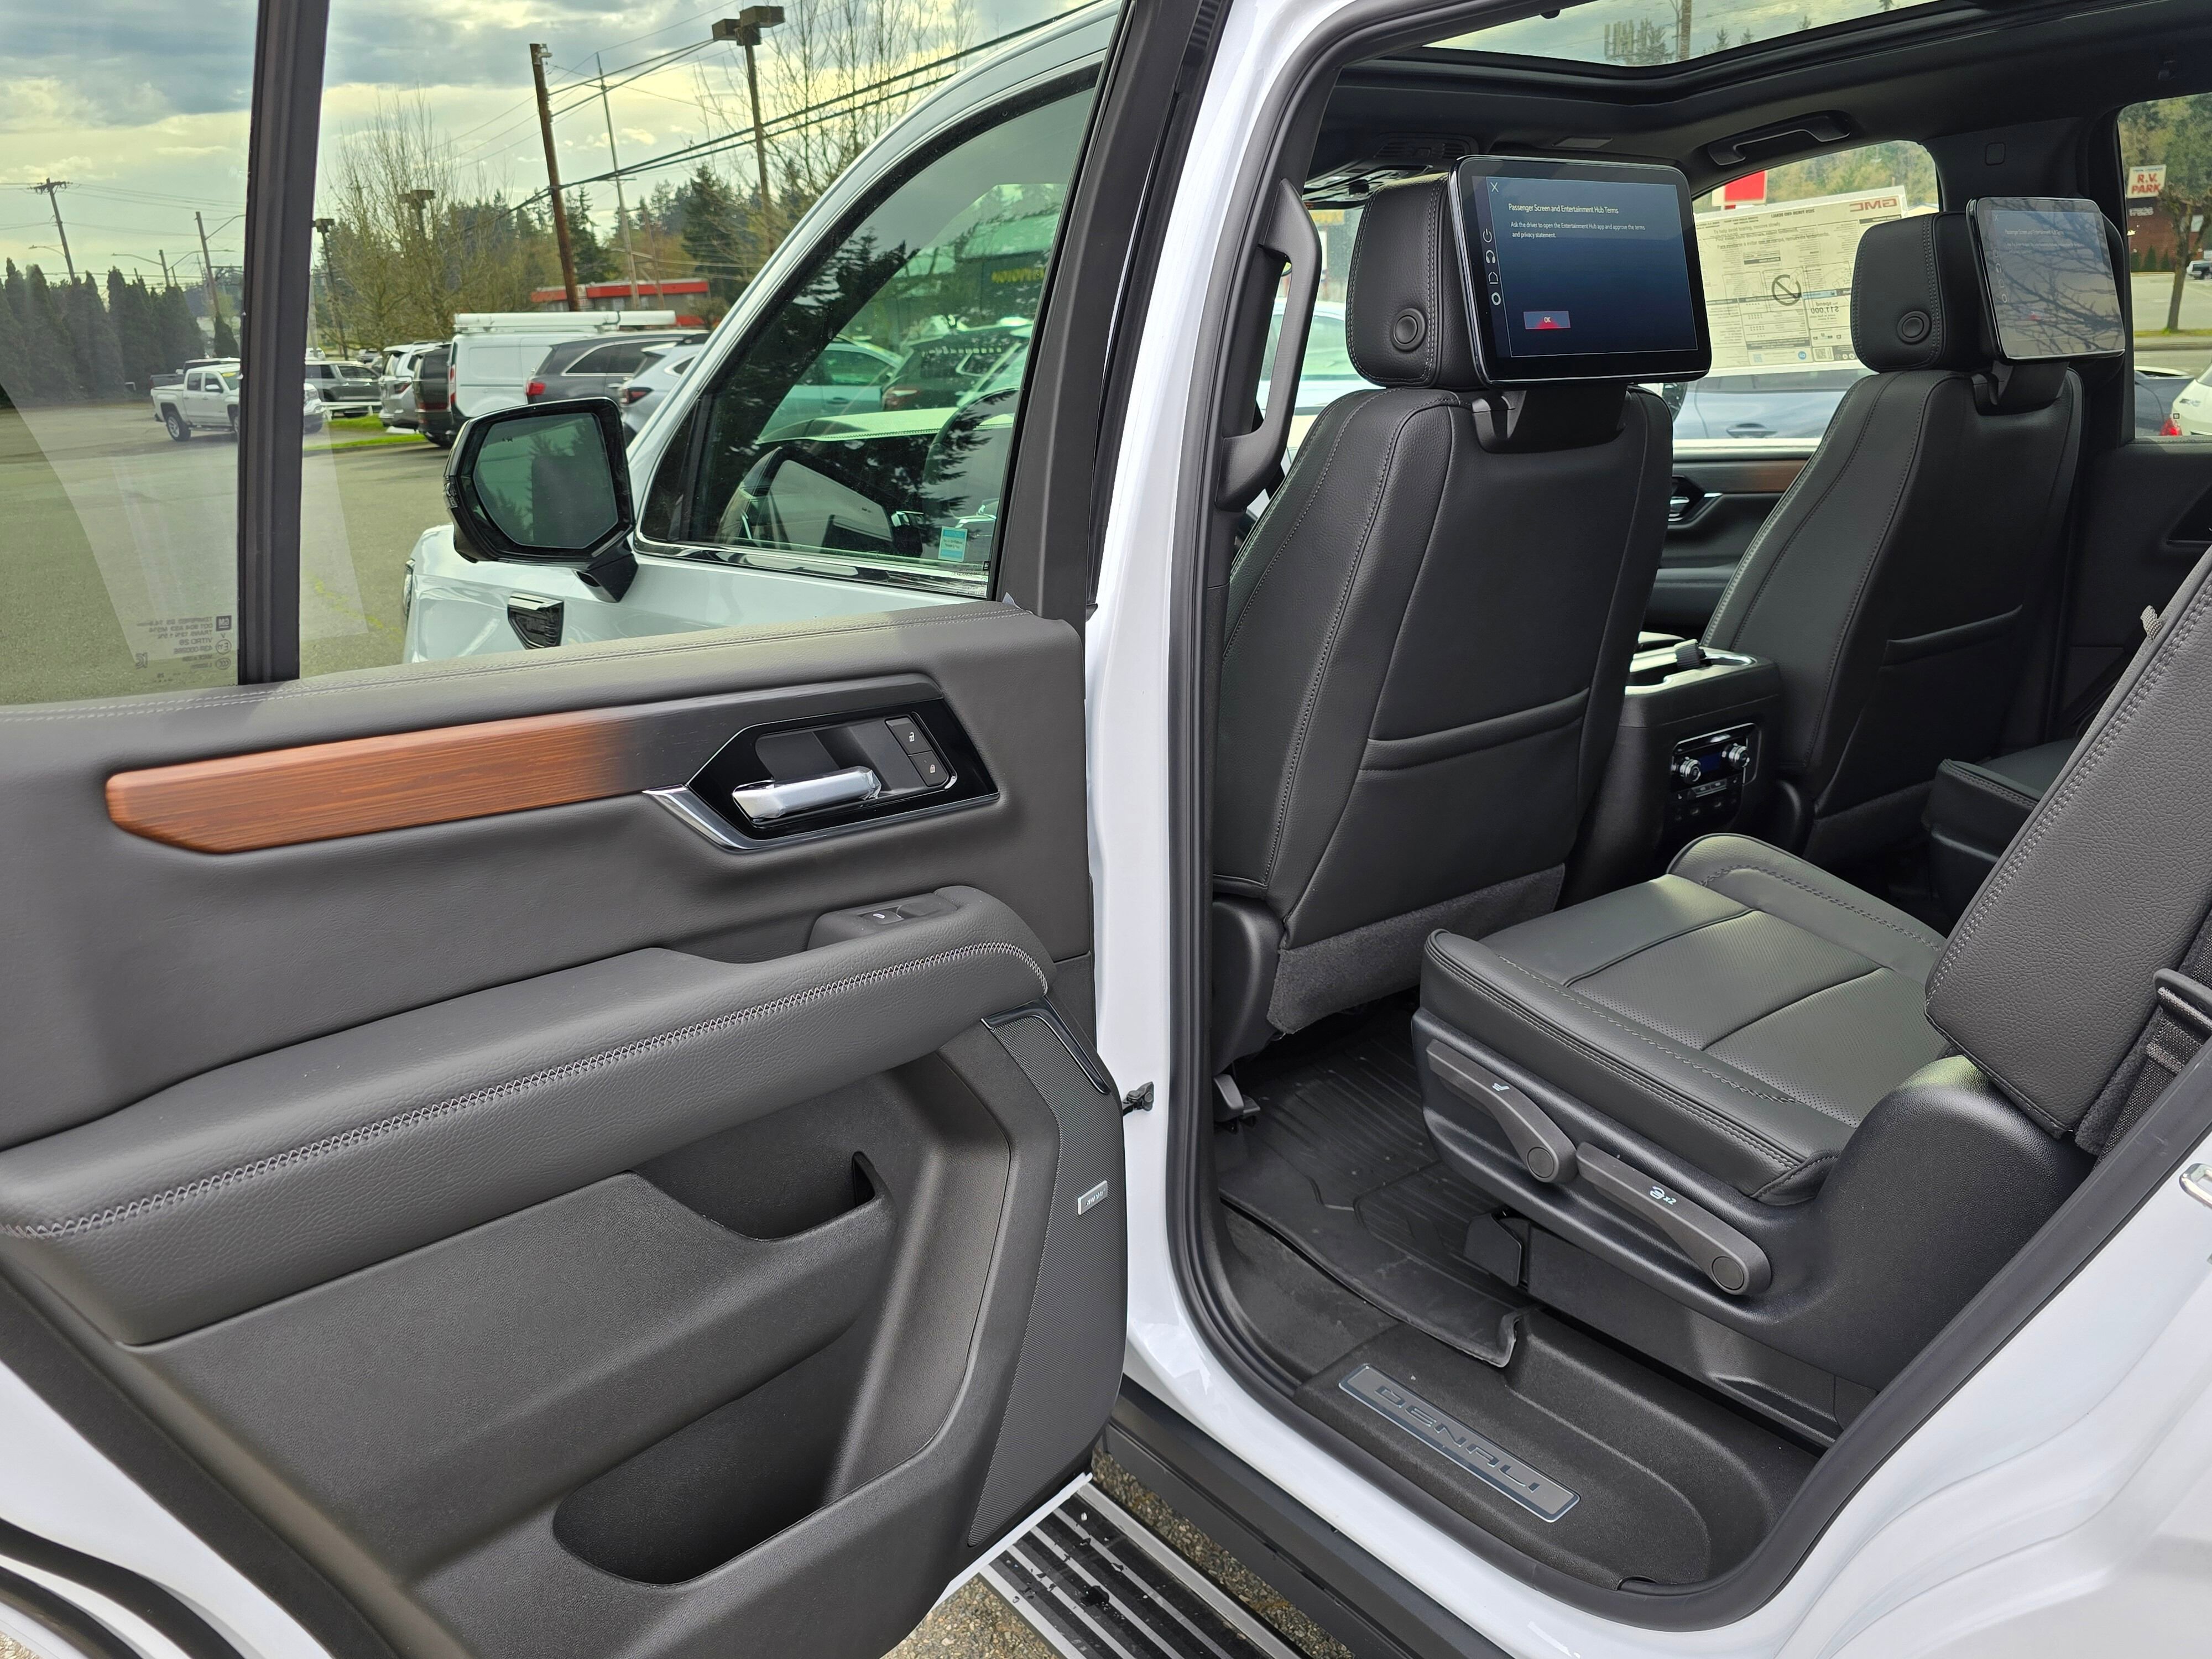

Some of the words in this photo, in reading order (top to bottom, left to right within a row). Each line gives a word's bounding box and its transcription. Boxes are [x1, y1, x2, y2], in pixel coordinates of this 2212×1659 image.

[2137, 173, 2157, 183] R.V.
[2131, 184, 2161, 194] PARK
[1508, 203, 1533, 212] Passenger
[1663, 1196, 1677, 1205] x2
[1375, 1385, 1540, 1493] DENALI
